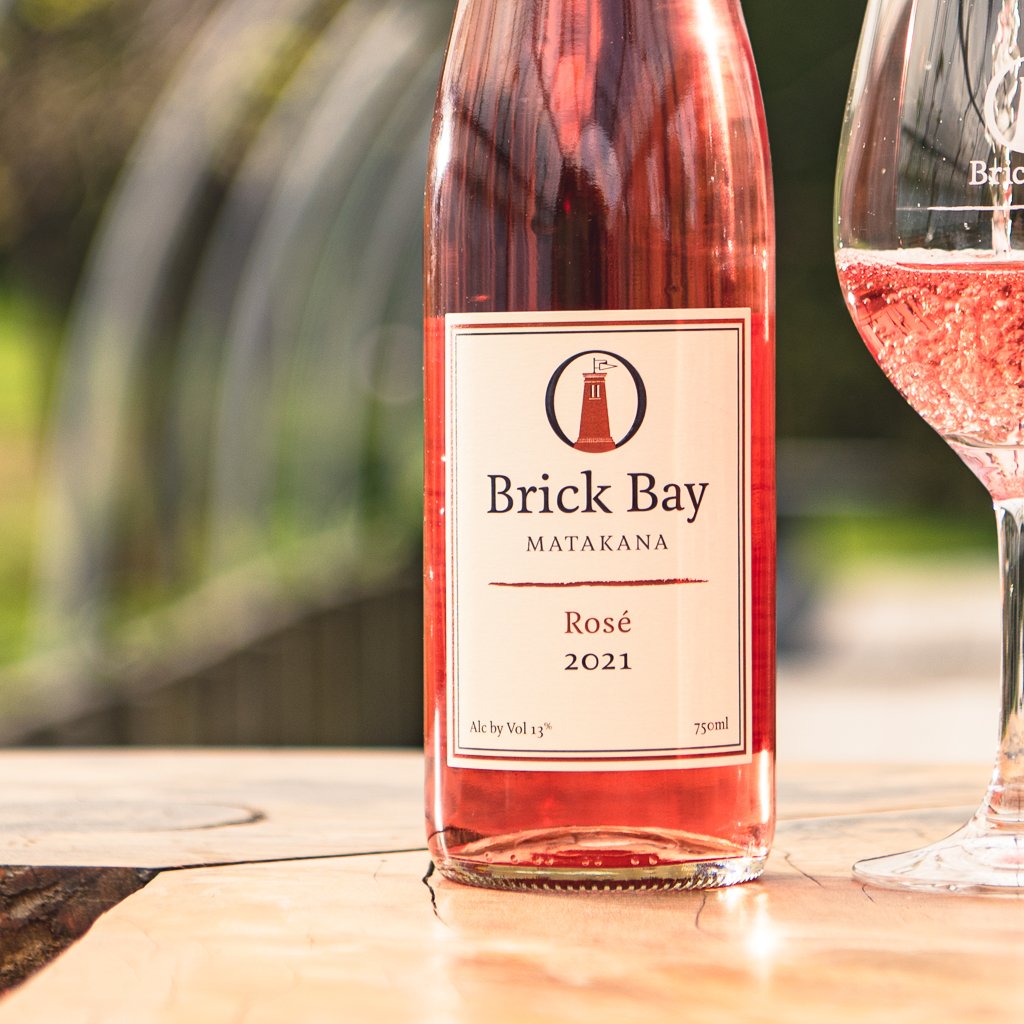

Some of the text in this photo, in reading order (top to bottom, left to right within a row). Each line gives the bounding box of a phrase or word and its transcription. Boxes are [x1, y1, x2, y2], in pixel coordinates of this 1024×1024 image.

[486, 470, 710, 523] Brick Bay
[525, 534, 669, 552] MATAKANA
[564, 609, 632, 635] Rosé
[564, 651, 632, 672] 2021
[469, 720, 552, 738] Alc by Vol 13%
[693, 716, 729, 736] 750ml
